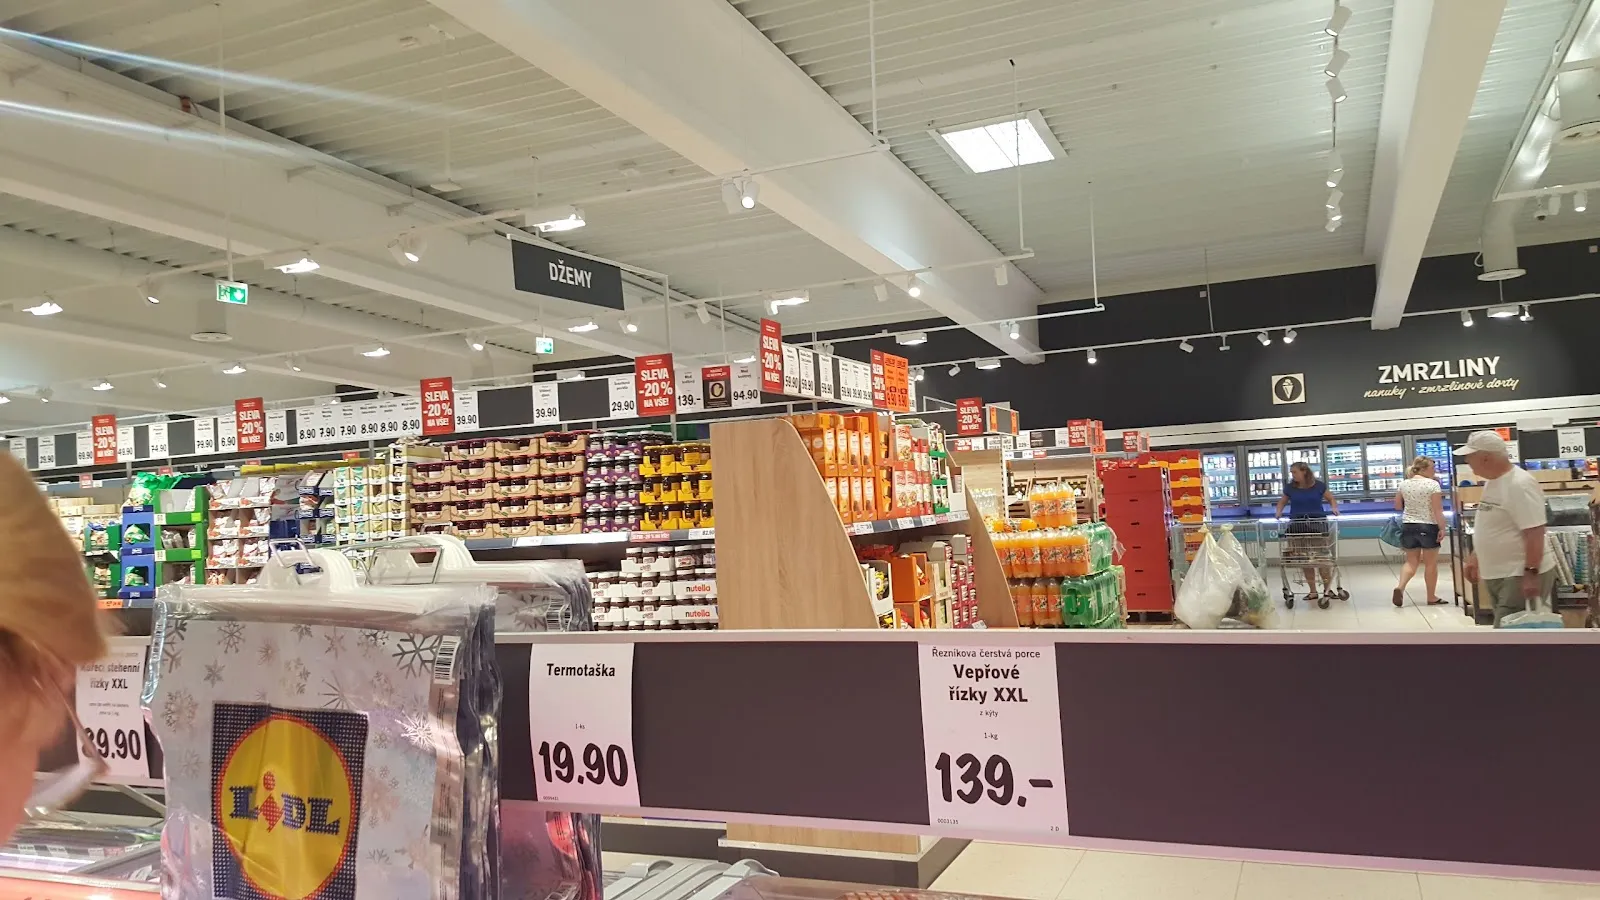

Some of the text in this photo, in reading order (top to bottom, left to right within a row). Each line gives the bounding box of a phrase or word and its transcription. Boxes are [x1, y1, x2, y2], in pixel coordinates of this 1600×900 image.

[549, 259, 592, 289] DŽEMY
[762, 335, 779, 351] SLEVA
[640, 367, 669, 381] SLEVA
[1377, 356, 1500, 384] ZMRZLINY
[1364, 377, 1520, 399] nanuky zmrzlinové dorty
[424, 390, 449, 403] SLEVA
[677, 394, 701, 407] 139.-
[733, 389, 758, 401] 94.90
[611, 400, 635, 412] 29.90
[643, 397, 669, 408] NA VŠE!
[239, 409, 261, 421] SLEVA
[535, 407, 557, 419] 39.90
[960, 406, 979, 414] SLEVA
[402, 419, 420, 431] 8.90
[427, 418, 436, 427] NA
[456, 414, 477, 426] 39.90
[95, 426, 114, 436] SLEVA
[319, 426, 336, 438] 7.90
[339, 424, 357, 436] 7.90
[360, 422, 378, 434] 8.90
[380, 421, 398, 433] 8.90
[268, 431, 285, 443] 6.90
[299, 428, 316, 440] 8.90
[221, 436, 236, 447] 6.90
[1560, 445, 1583, 453] 29.90
[686, 583, 711, 593] nutella
[685, 607, 710, 618] nutella
[932, 646, 1041, 660] Řezníkova čerstvá porce
[547, 663, 616, 677] Termotaška
[953, 663, 1021, 682] Vepřové
[111, 678, 128, 689] XXL
[948, 685, 1029, 705] řízky XXL
[985, 709, 999, 717] kýty
[984, 732, 999, 740] 1-kg
[538, 741, 628, 787] 19.90
[934, 752, 1054, 808] 139.-
